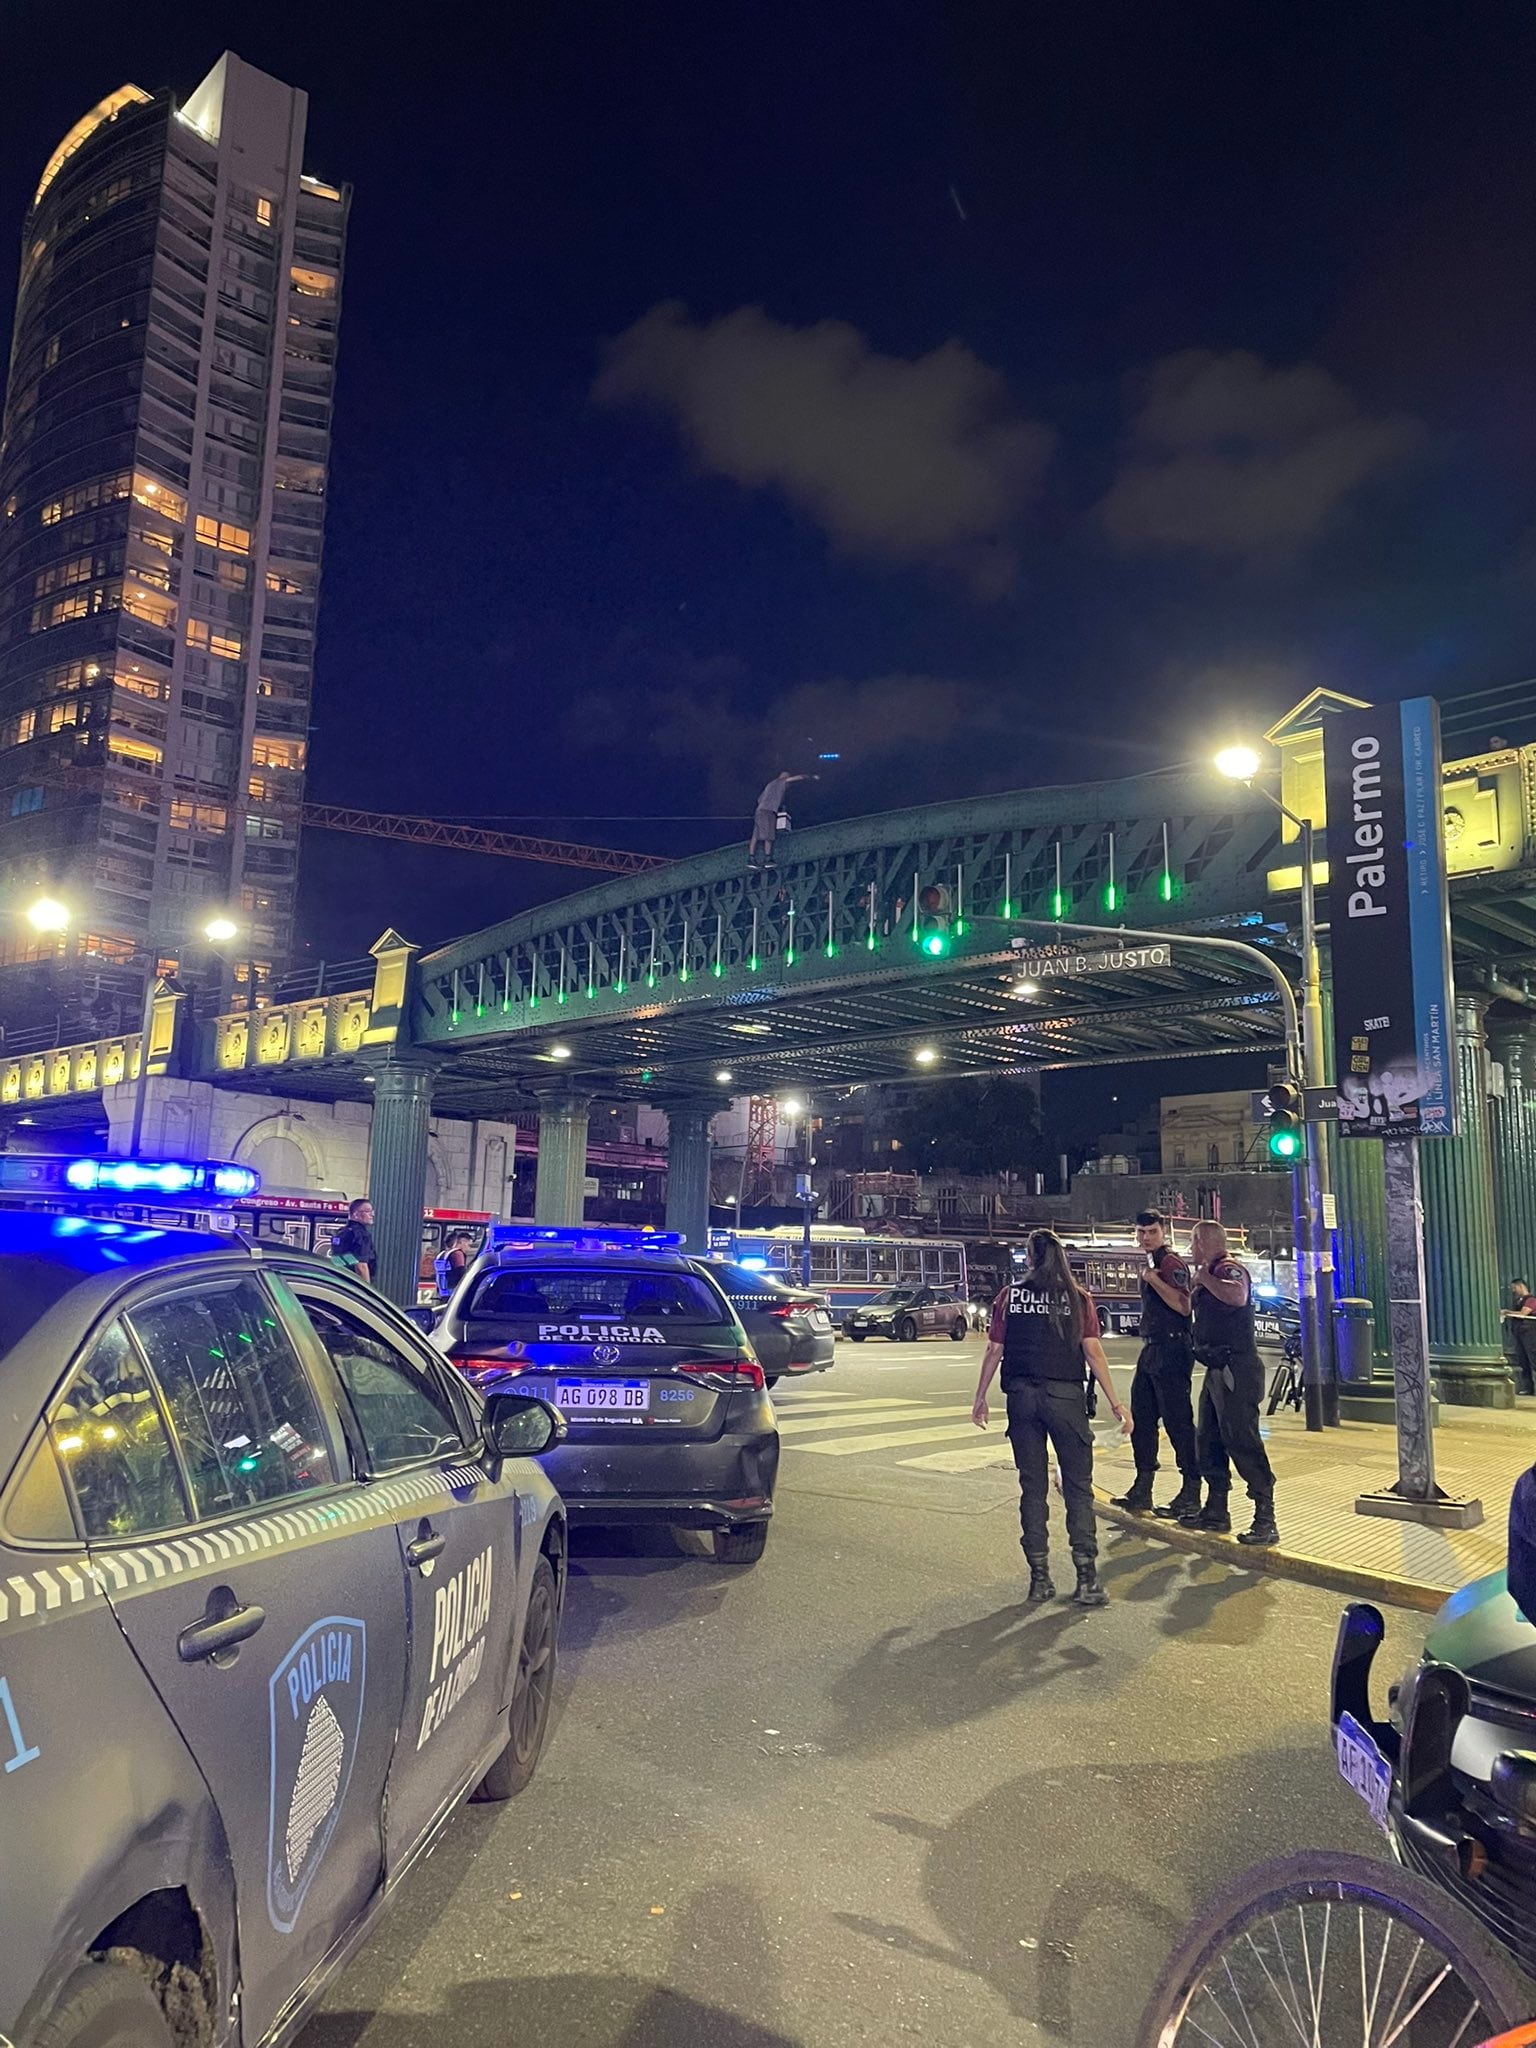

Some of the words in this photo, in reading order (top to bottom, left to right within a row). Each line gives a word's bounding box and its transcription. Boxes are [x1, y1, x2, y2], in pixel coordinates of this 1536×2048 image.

[1346, 736, 1388, 918] Palermo
[1017, 958, 1069, 979] JUAN
[1076, 956, 1092, 973] B.
[1098, 948, 1165, 970] JUSTO
[1428, 1004, 1441, 1044] MARTÍN
[1432, 1046, 1442, 1068] SAN
[1431, 1070, 1443, 1101] LÍNEA
[1318, 1099, 1337, 1109] Jua
[240, 1197, 279, 1207] Congreso
[284, 1199, 298, 1208] Av.
[299, 1200, 322, 1210] Santa
[322, 1202, 333, 1210] Fe
[424, 1209, 434, 1217] 12
[417, 1289, 433, 1305] 12
[1010, 1288, 1070, 1305] POLICA
[737, 1300, 758, 1311] 911
[1010, 1303, 1022, 1314] DE
[1023, 1304, 1035, 1314] LA
[1036, 1304, 1070, 1316] CIUD
[1119, 1315, 1133, 1328] BA
[539, 1325, 664, 1339] POLICIA
[597, 1336, 667, 1344] CIUDAD
[561, 1388, 581, 1405] AG
[587, 1389, 617, 1406] 098
[624, 1389, 644, 1406] DB
[659, 1389, 695, 1401] 8256
[604, 1417, 631, 1425] Seguridad
[430, 1546, 492, 1684] POLICIA
[287, 1631, 352, 1721] POLICIA
[417, 1686, 441, 1751] DE
[433, 1672, 453, 1732] LA
